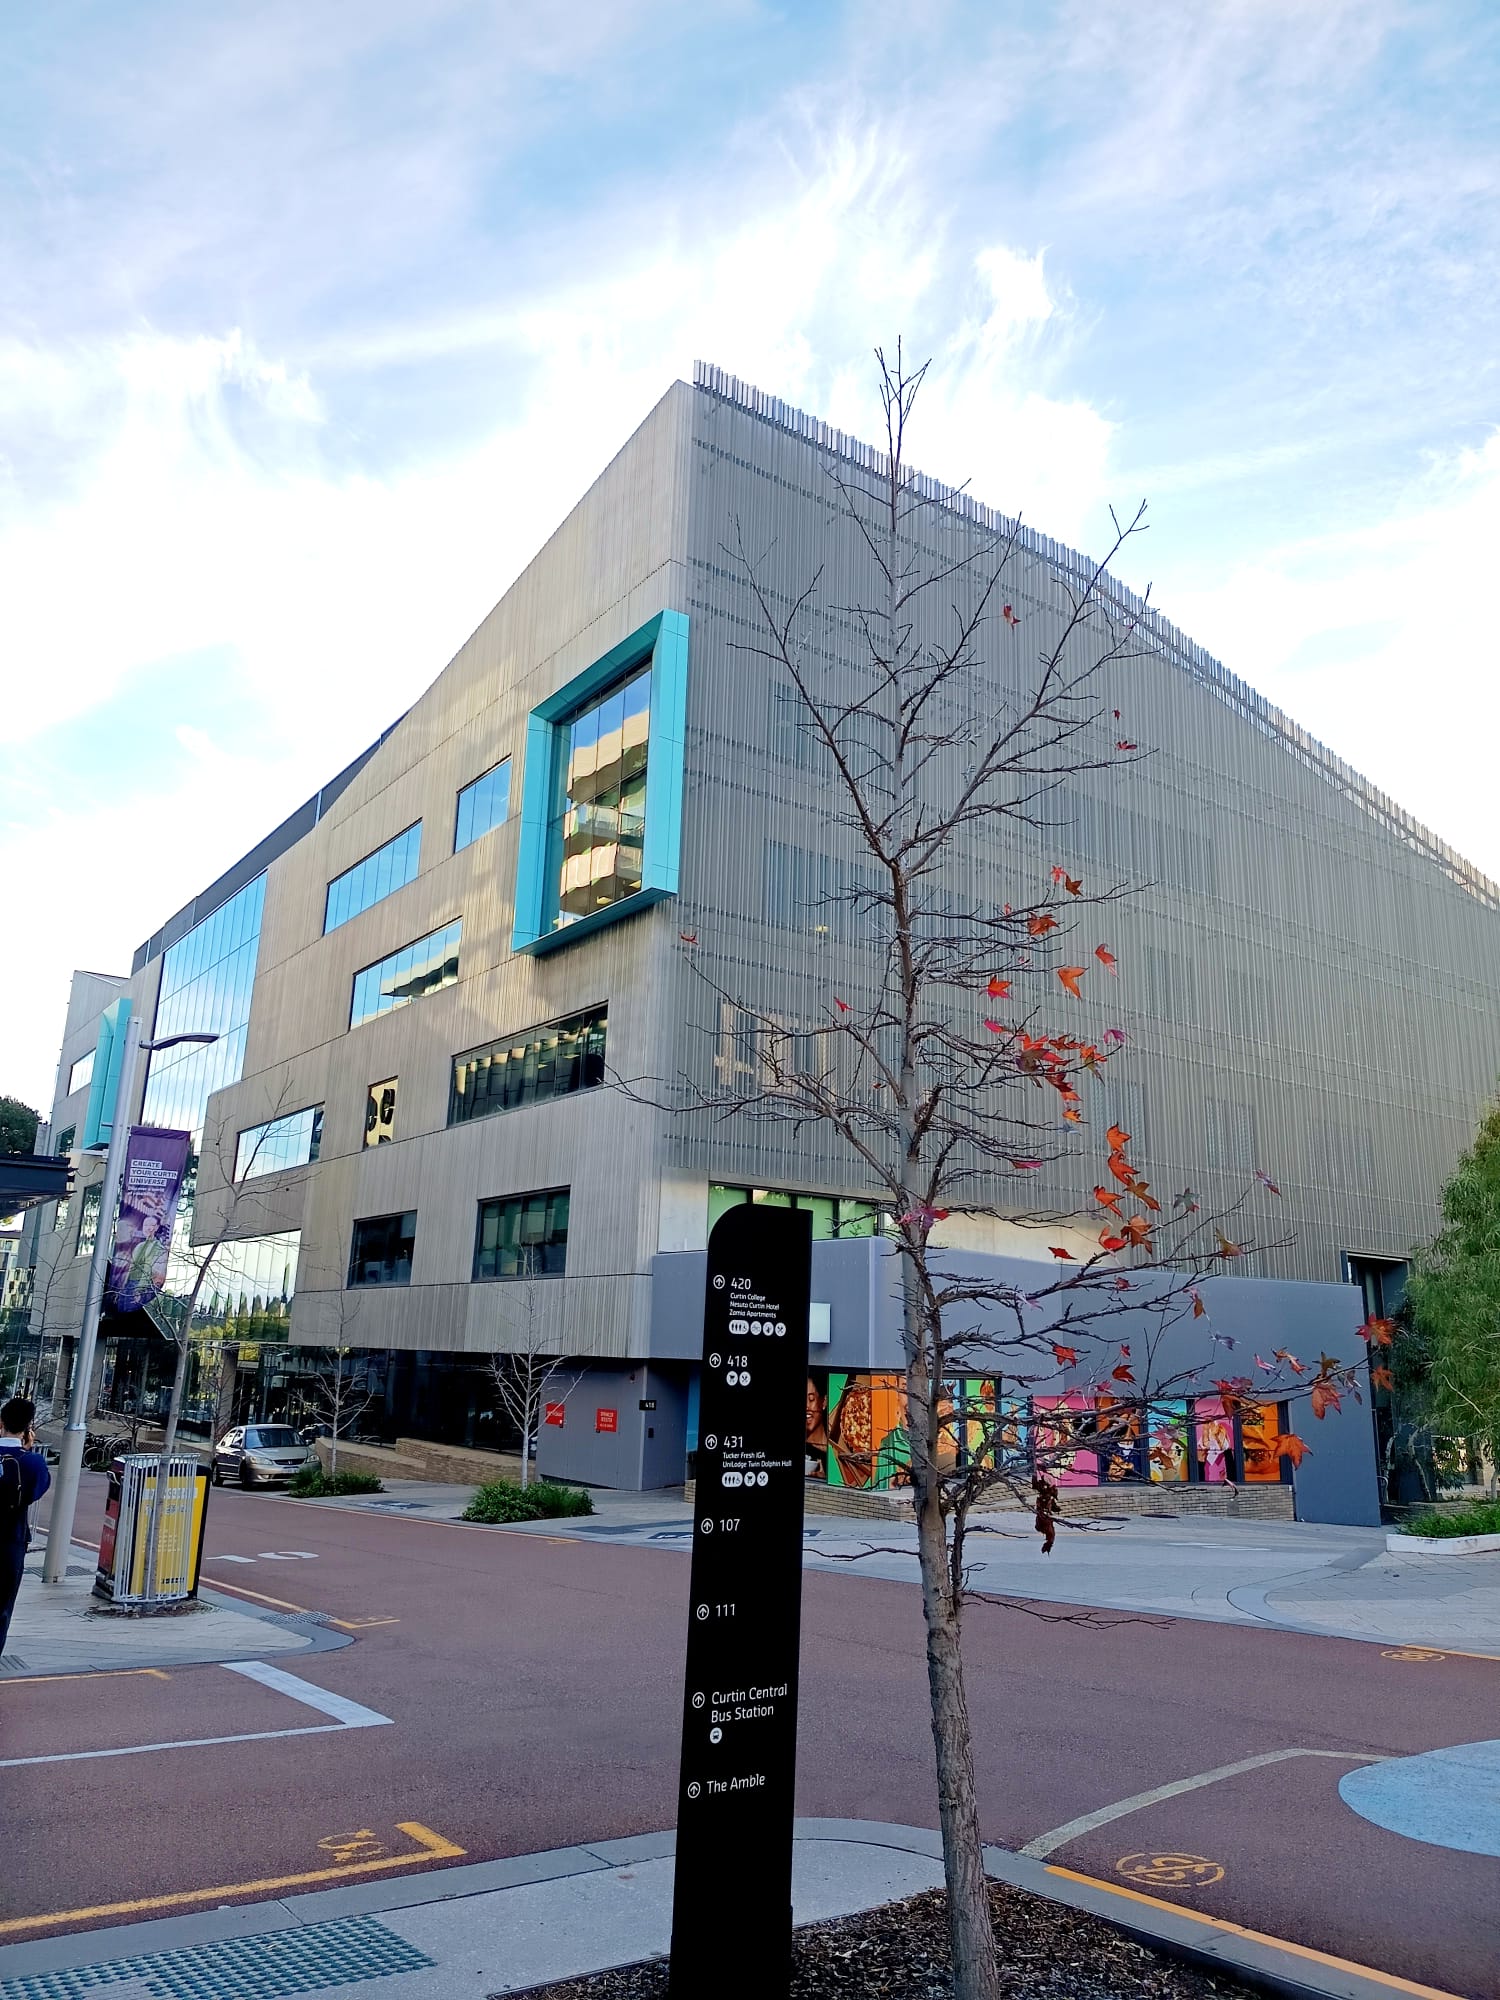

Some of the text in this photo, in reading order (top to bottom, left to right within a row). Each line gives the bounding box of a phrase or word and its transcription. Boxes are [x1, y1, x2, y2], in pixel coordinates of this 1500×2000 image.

[132, 1160, 161, 1168] CREATE
[131, 1169, 151, 1177] YOUR
[130, 1177, 166, 1185] UNIVERSE
[730, 1277, 752, 1290] 420
[730, 1292, 766, 1303] Curtin College
[749, 1302, 765, 1310] Curtin
[766, 1303, 780, 1311] Hotel
[747, 1310, 777, 1319] Apartments
[727, 1355, 748, 1368] 418
[723, 1435, 743, 1449] 431
[723, 1451, 766, 1460] Tucker Fresh IGA
[748, 1460, 760, 1468] Twin
[761, 1460, 781, 1469] Dolphin
[719, 1518, 741, 1532] 107
[715, 1603, 735, 1617] 111
[711, 1683, 788, 1705] Curtin Central
[711, 1704, 774, 1723] Bus Station
[706, 1773, 766, 1794] The Amble
